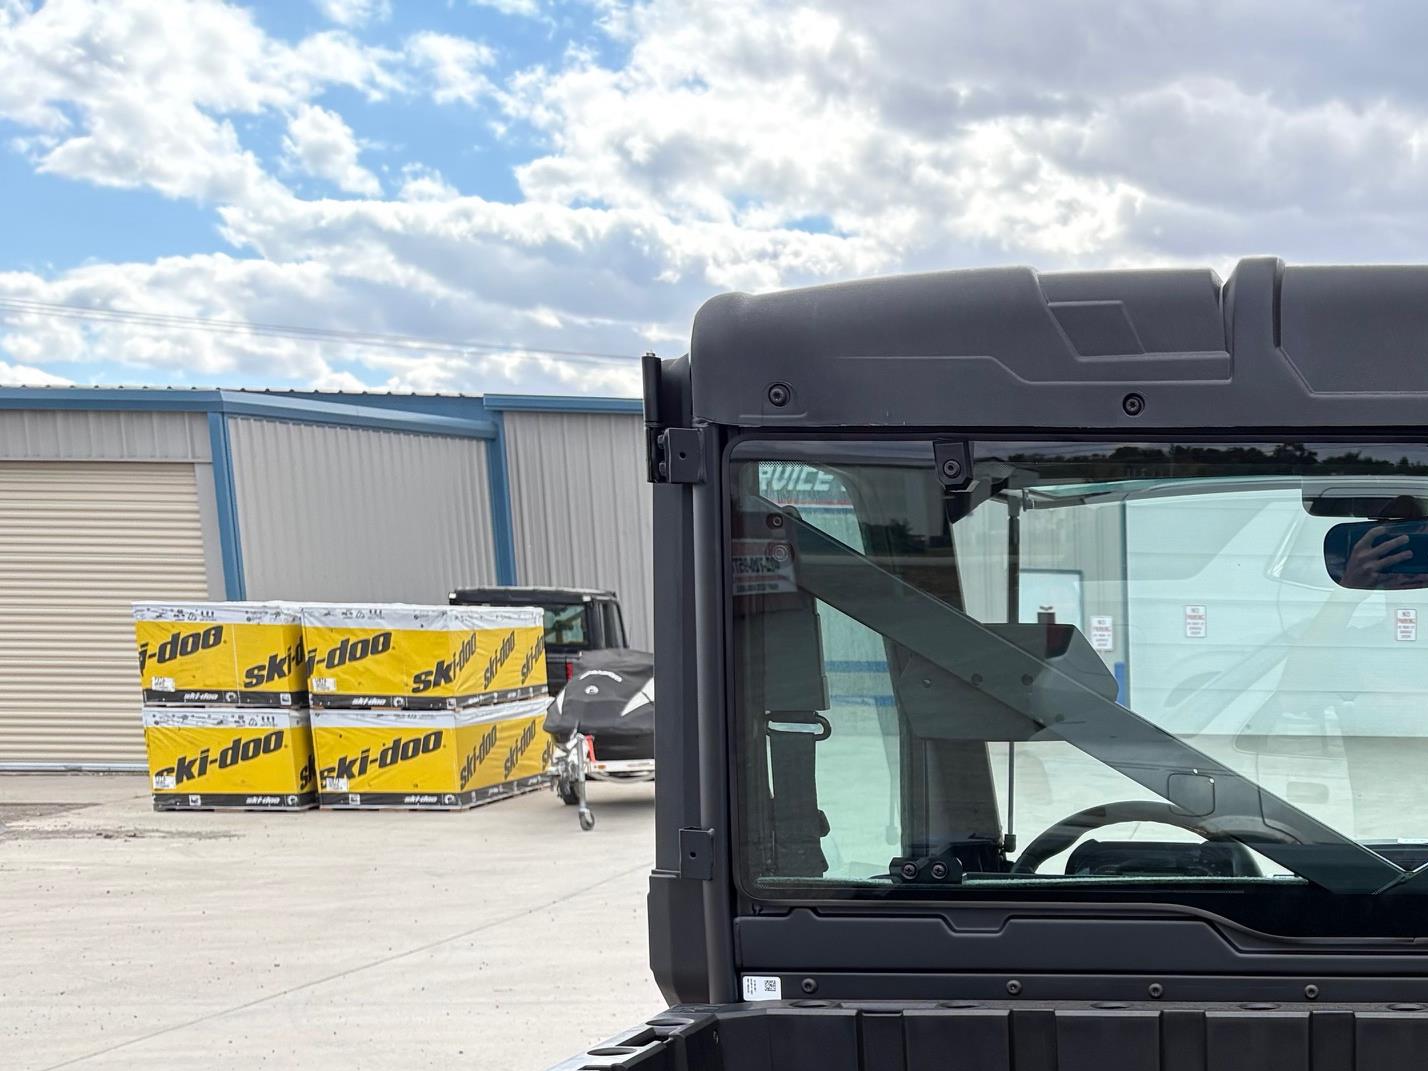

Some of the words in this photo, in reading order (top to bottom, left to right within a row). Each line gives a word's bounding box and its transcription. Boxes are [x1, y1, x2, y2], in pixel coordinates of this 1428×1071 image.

[305, 631, 392, 678] i-doo
[411, 632, 476, 694] ski-doo
[484, 630, 515, 691] ski-doo
[521, 635, 544, 685] ski-do
[460, 725, 497, 791] ski-doo
[504, 719, 535, 781] ski-doo
